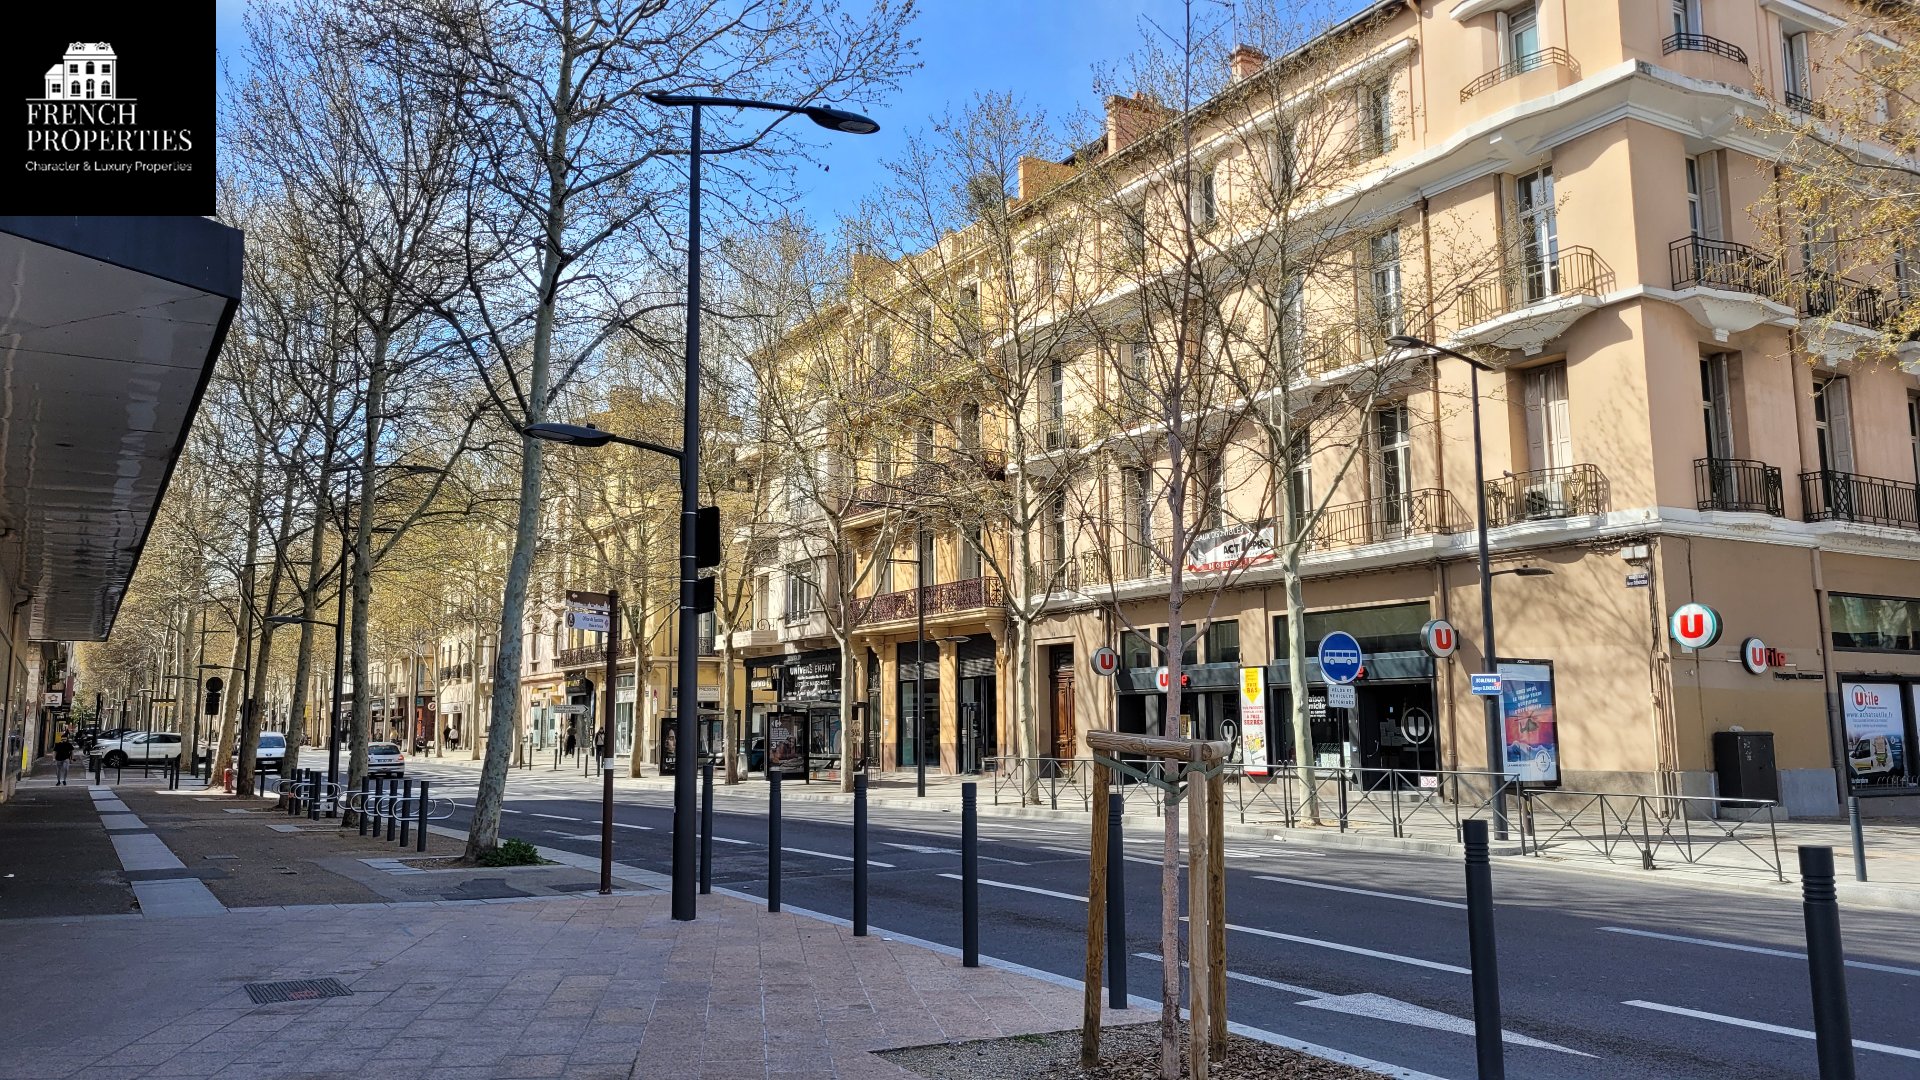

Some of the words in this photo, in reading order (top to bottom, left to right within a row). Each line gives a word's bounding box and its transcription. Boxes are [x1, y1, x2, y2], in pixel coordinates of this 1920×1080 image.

[1680, 614, 1703, 638] U
[1435, 629, 1452, 650] U
[814, 663, 836, 673] ENFANT
[1100, 654, 1114, 669] U
[1854, 691, 1879, 706] Utile
